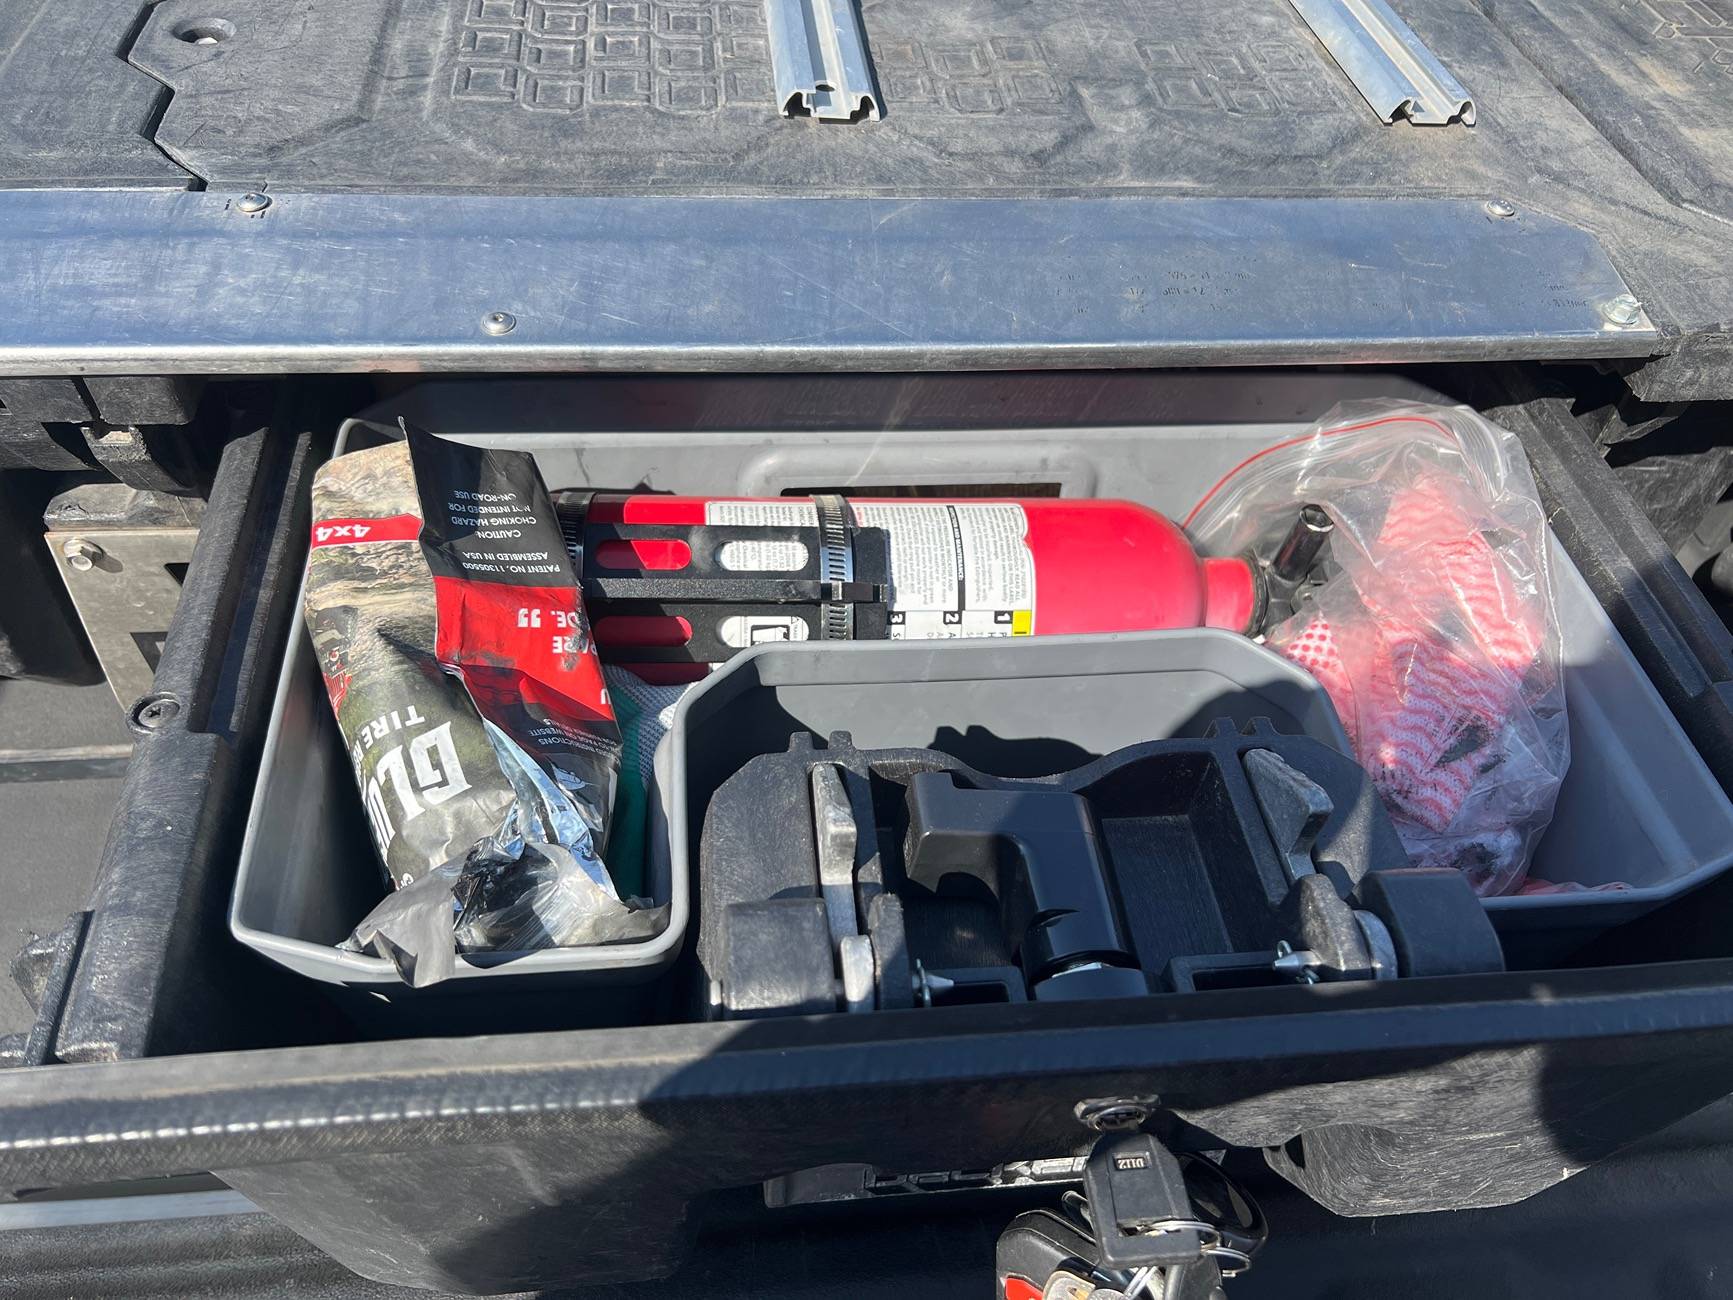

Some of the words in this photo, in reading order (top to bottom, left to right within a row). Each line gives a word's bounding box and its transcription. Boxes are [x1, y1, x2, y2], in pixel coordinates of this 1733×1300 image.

[454, 490, 470, 499] USE
[448, 503, 466, 512] FOR
[467, 505, 510, 513] INTENDED
[452, 517, 488, 526] HAZARD
[490, 517, 536, 525] CHOKING
[316, 524, 371, 542] 4x4
[475, 530, 521, 538] CAUTION:
[484, 552, 495, 560] IN
[496, 552, 548, 560] ASSEMBLED
[955, 539, 964, 580] MAINTENANCE:
[462, 562, 504, 572] 11305500
[527, 564, 560, 573] PATENT
[891, 614, 903, 622] 3
[945, 613, 959, 622] 2
[997, 613, 1010, 621] 1
[361, 705, 425, 749] TIRE
